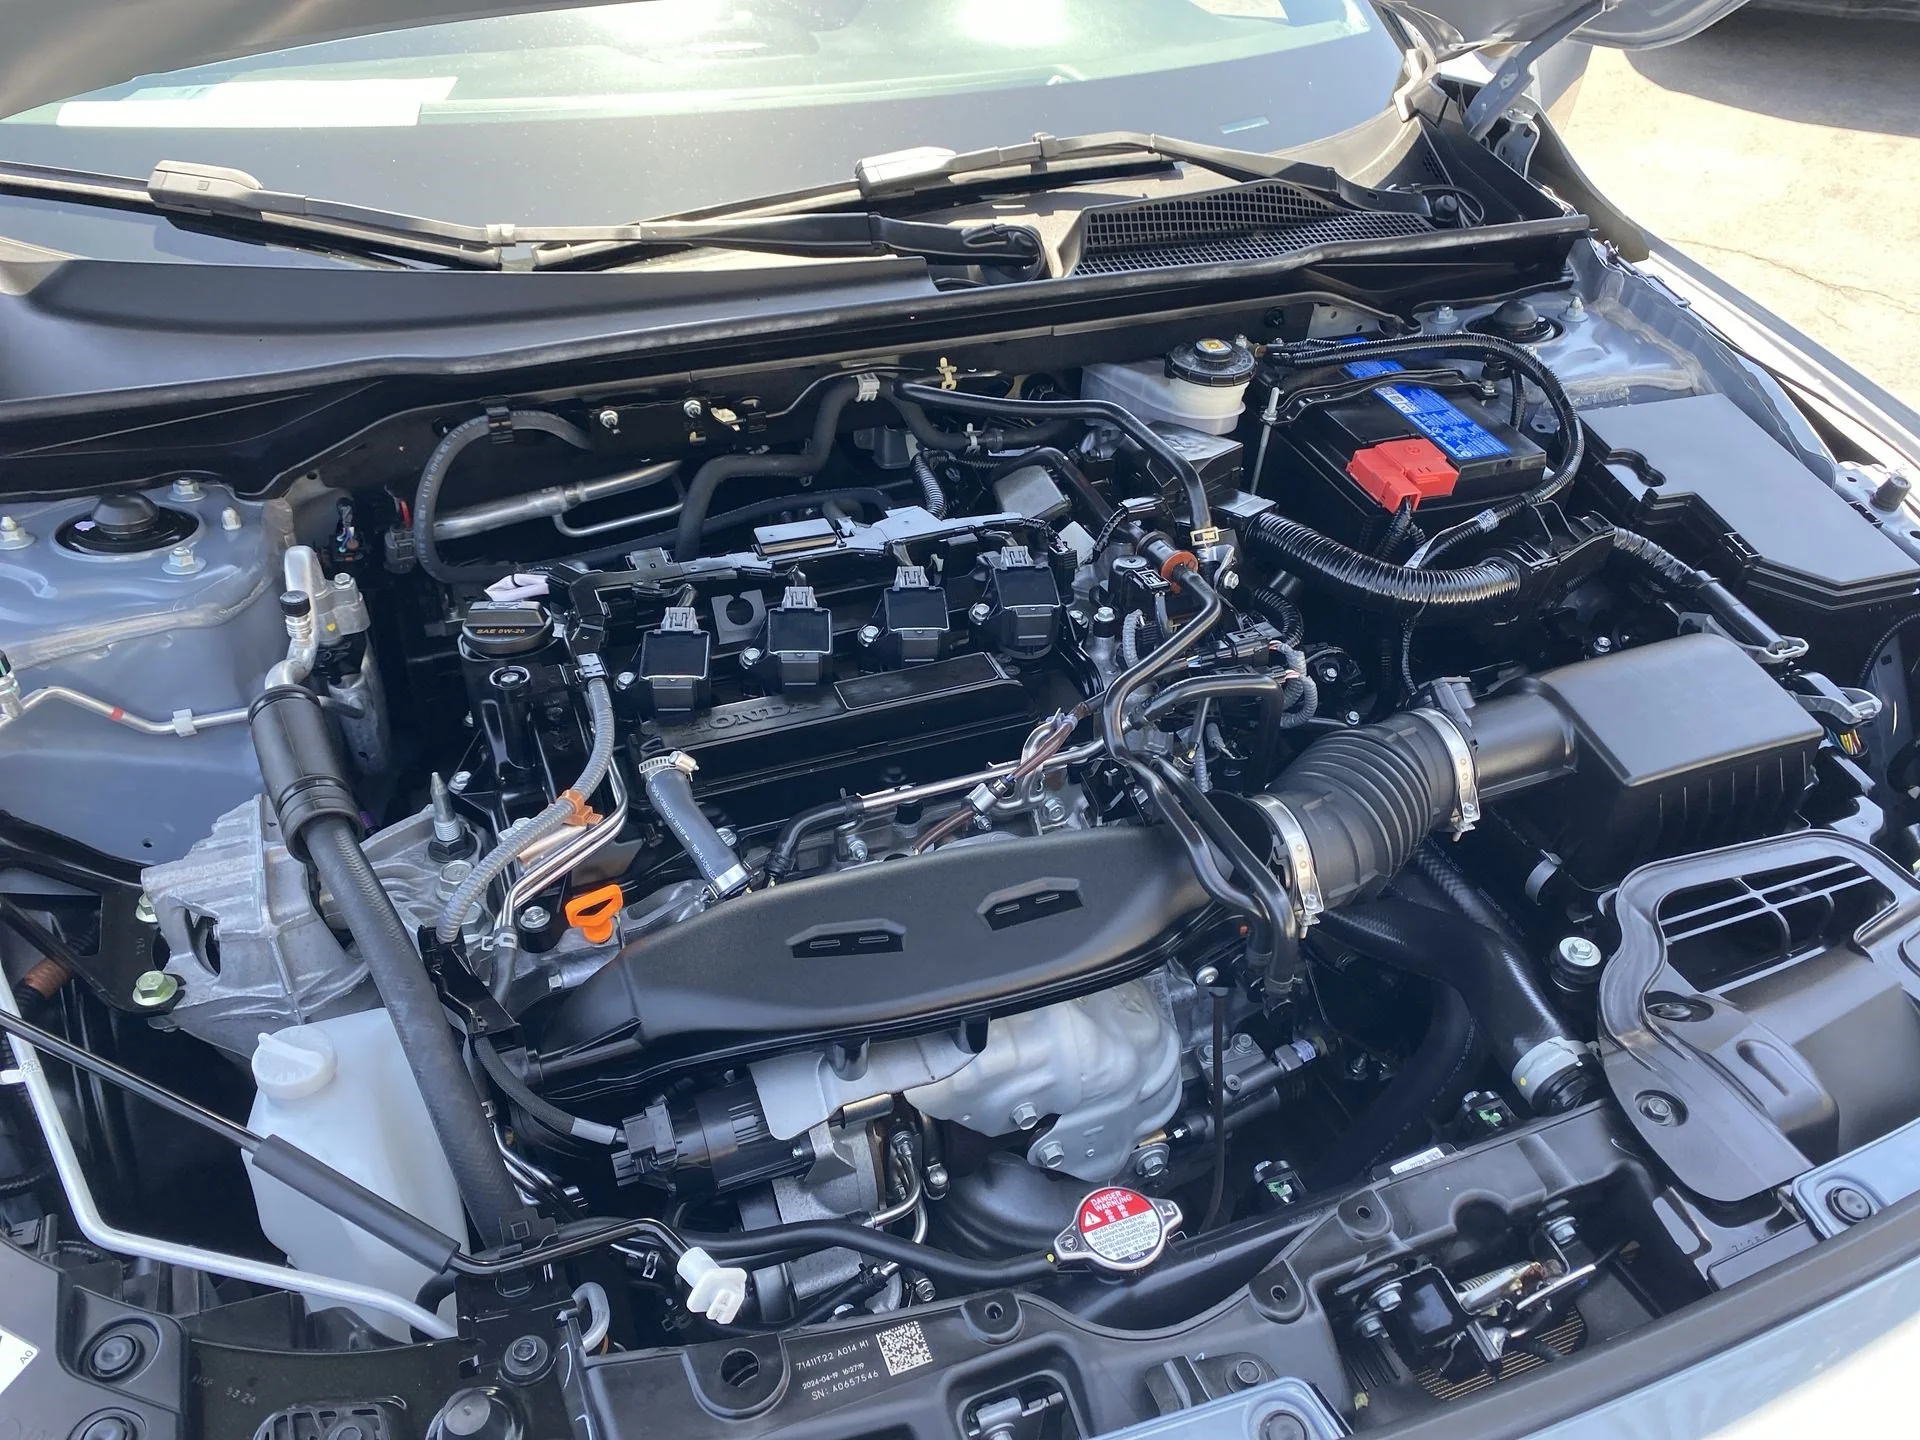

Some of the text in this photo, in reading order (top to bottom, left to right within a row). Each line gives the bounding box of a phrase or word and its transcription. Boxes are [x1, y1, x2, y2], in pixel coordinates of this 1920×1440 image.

[681, 702, 822, 737] HONDA
[1091, 1191, 1121, 1205] DANGER
[1095, 1195, 1132, 1212] WARNUNG
[796, 1339, 869, 1371] 71411T22 A014 M1
[802, 1371, 839, 1390] 2024-04-19
[811, 1370, 880, 1401] SN: A0657546
